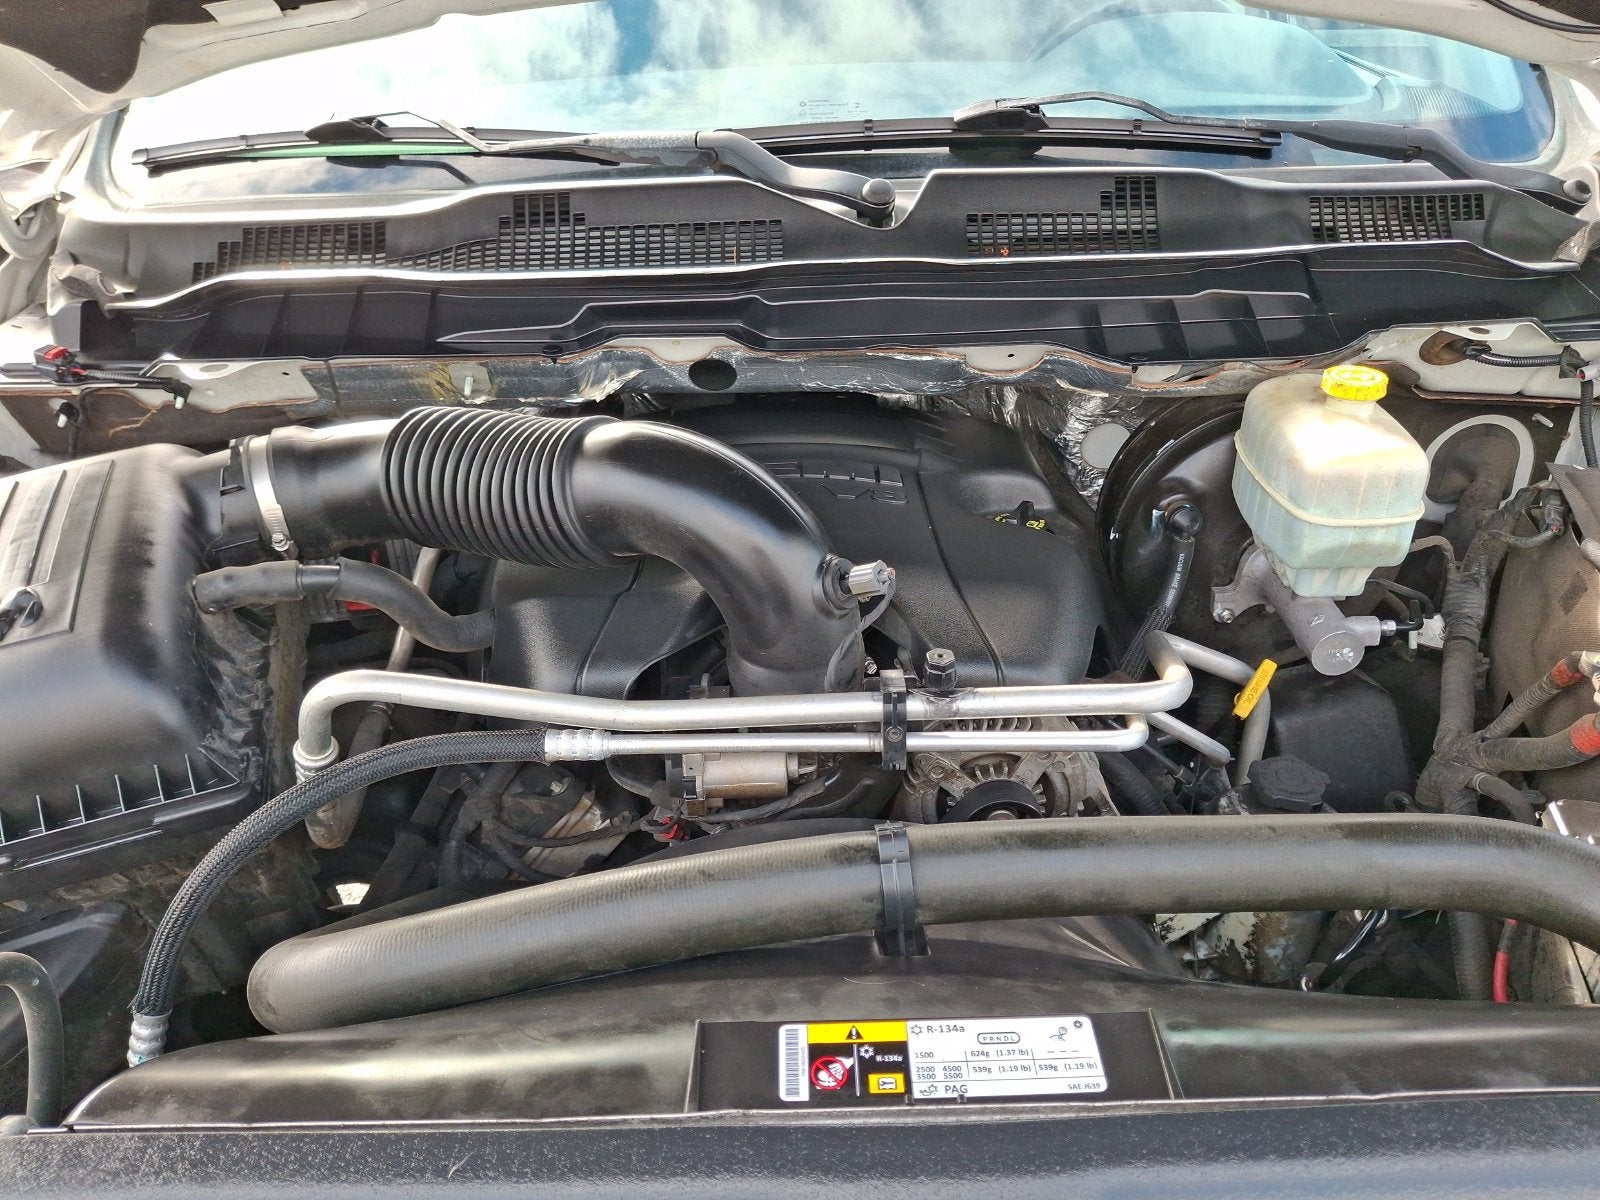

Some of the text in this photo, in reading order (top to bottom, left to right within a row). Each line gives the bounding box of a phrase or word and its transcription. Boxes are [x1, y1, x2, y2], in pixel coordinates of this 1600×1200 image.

[926, 1024, 965, 1034] R-134a
[915, 1051, 934, 1059] 1500
[970, 1048, 1029, 1058] 624g (1.37 lb)
[972, 1064, 1032, 1074] 539g (1.19 lb)
[1038, 1061, 1098, 1072] 539g (1.19 lb)
[943, 1072, 963, 1080] 5500
[944, 1084, 968, 1094] PAG
